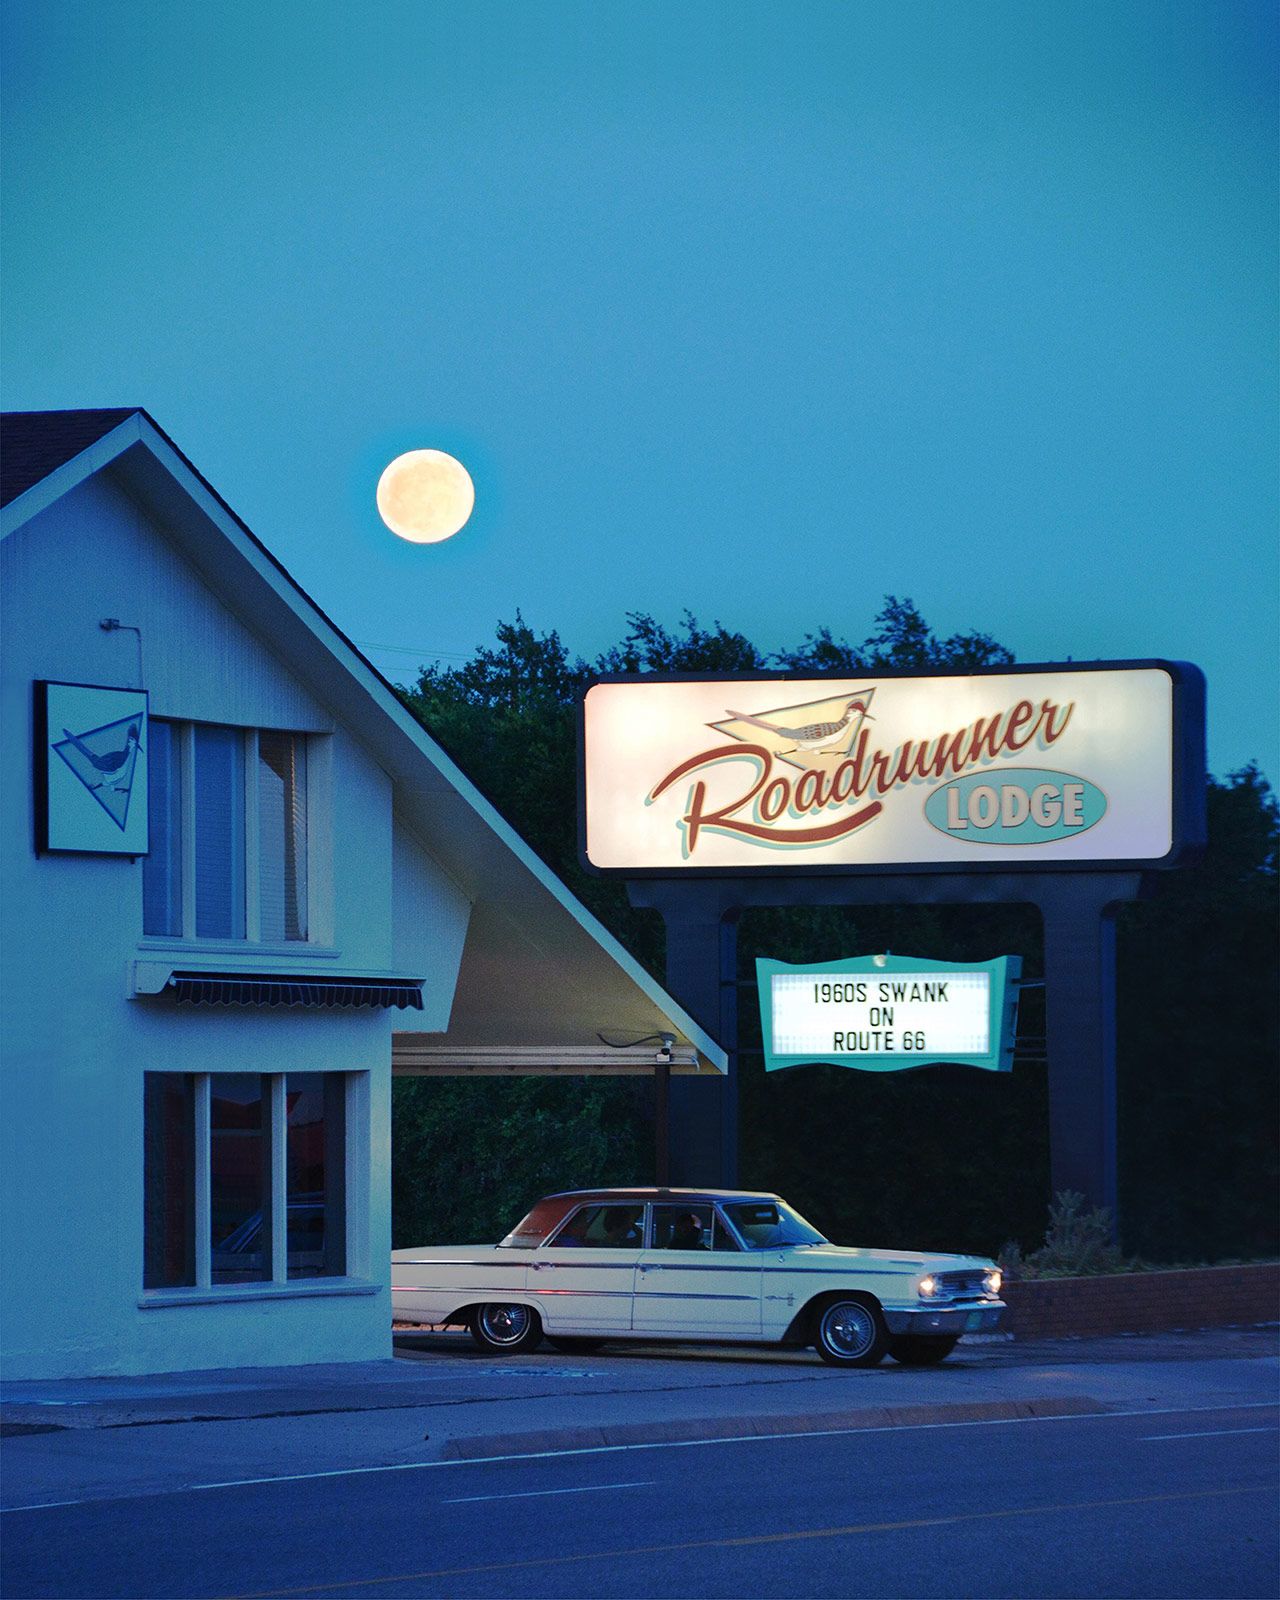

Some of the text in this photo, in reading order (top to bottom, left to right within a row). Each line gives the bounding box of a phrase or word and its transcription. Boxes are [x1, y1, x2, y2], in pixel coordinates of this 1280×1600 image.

[646, 699, 1075, 858] Roadrunner
[946, 783, 1085, 831] LODGE
[814, 982, 949, 1003] 1960S SWANK
[869, 1007, 894, 1027] ON
[833, 1031, 926, 1051] ROUTE 66
